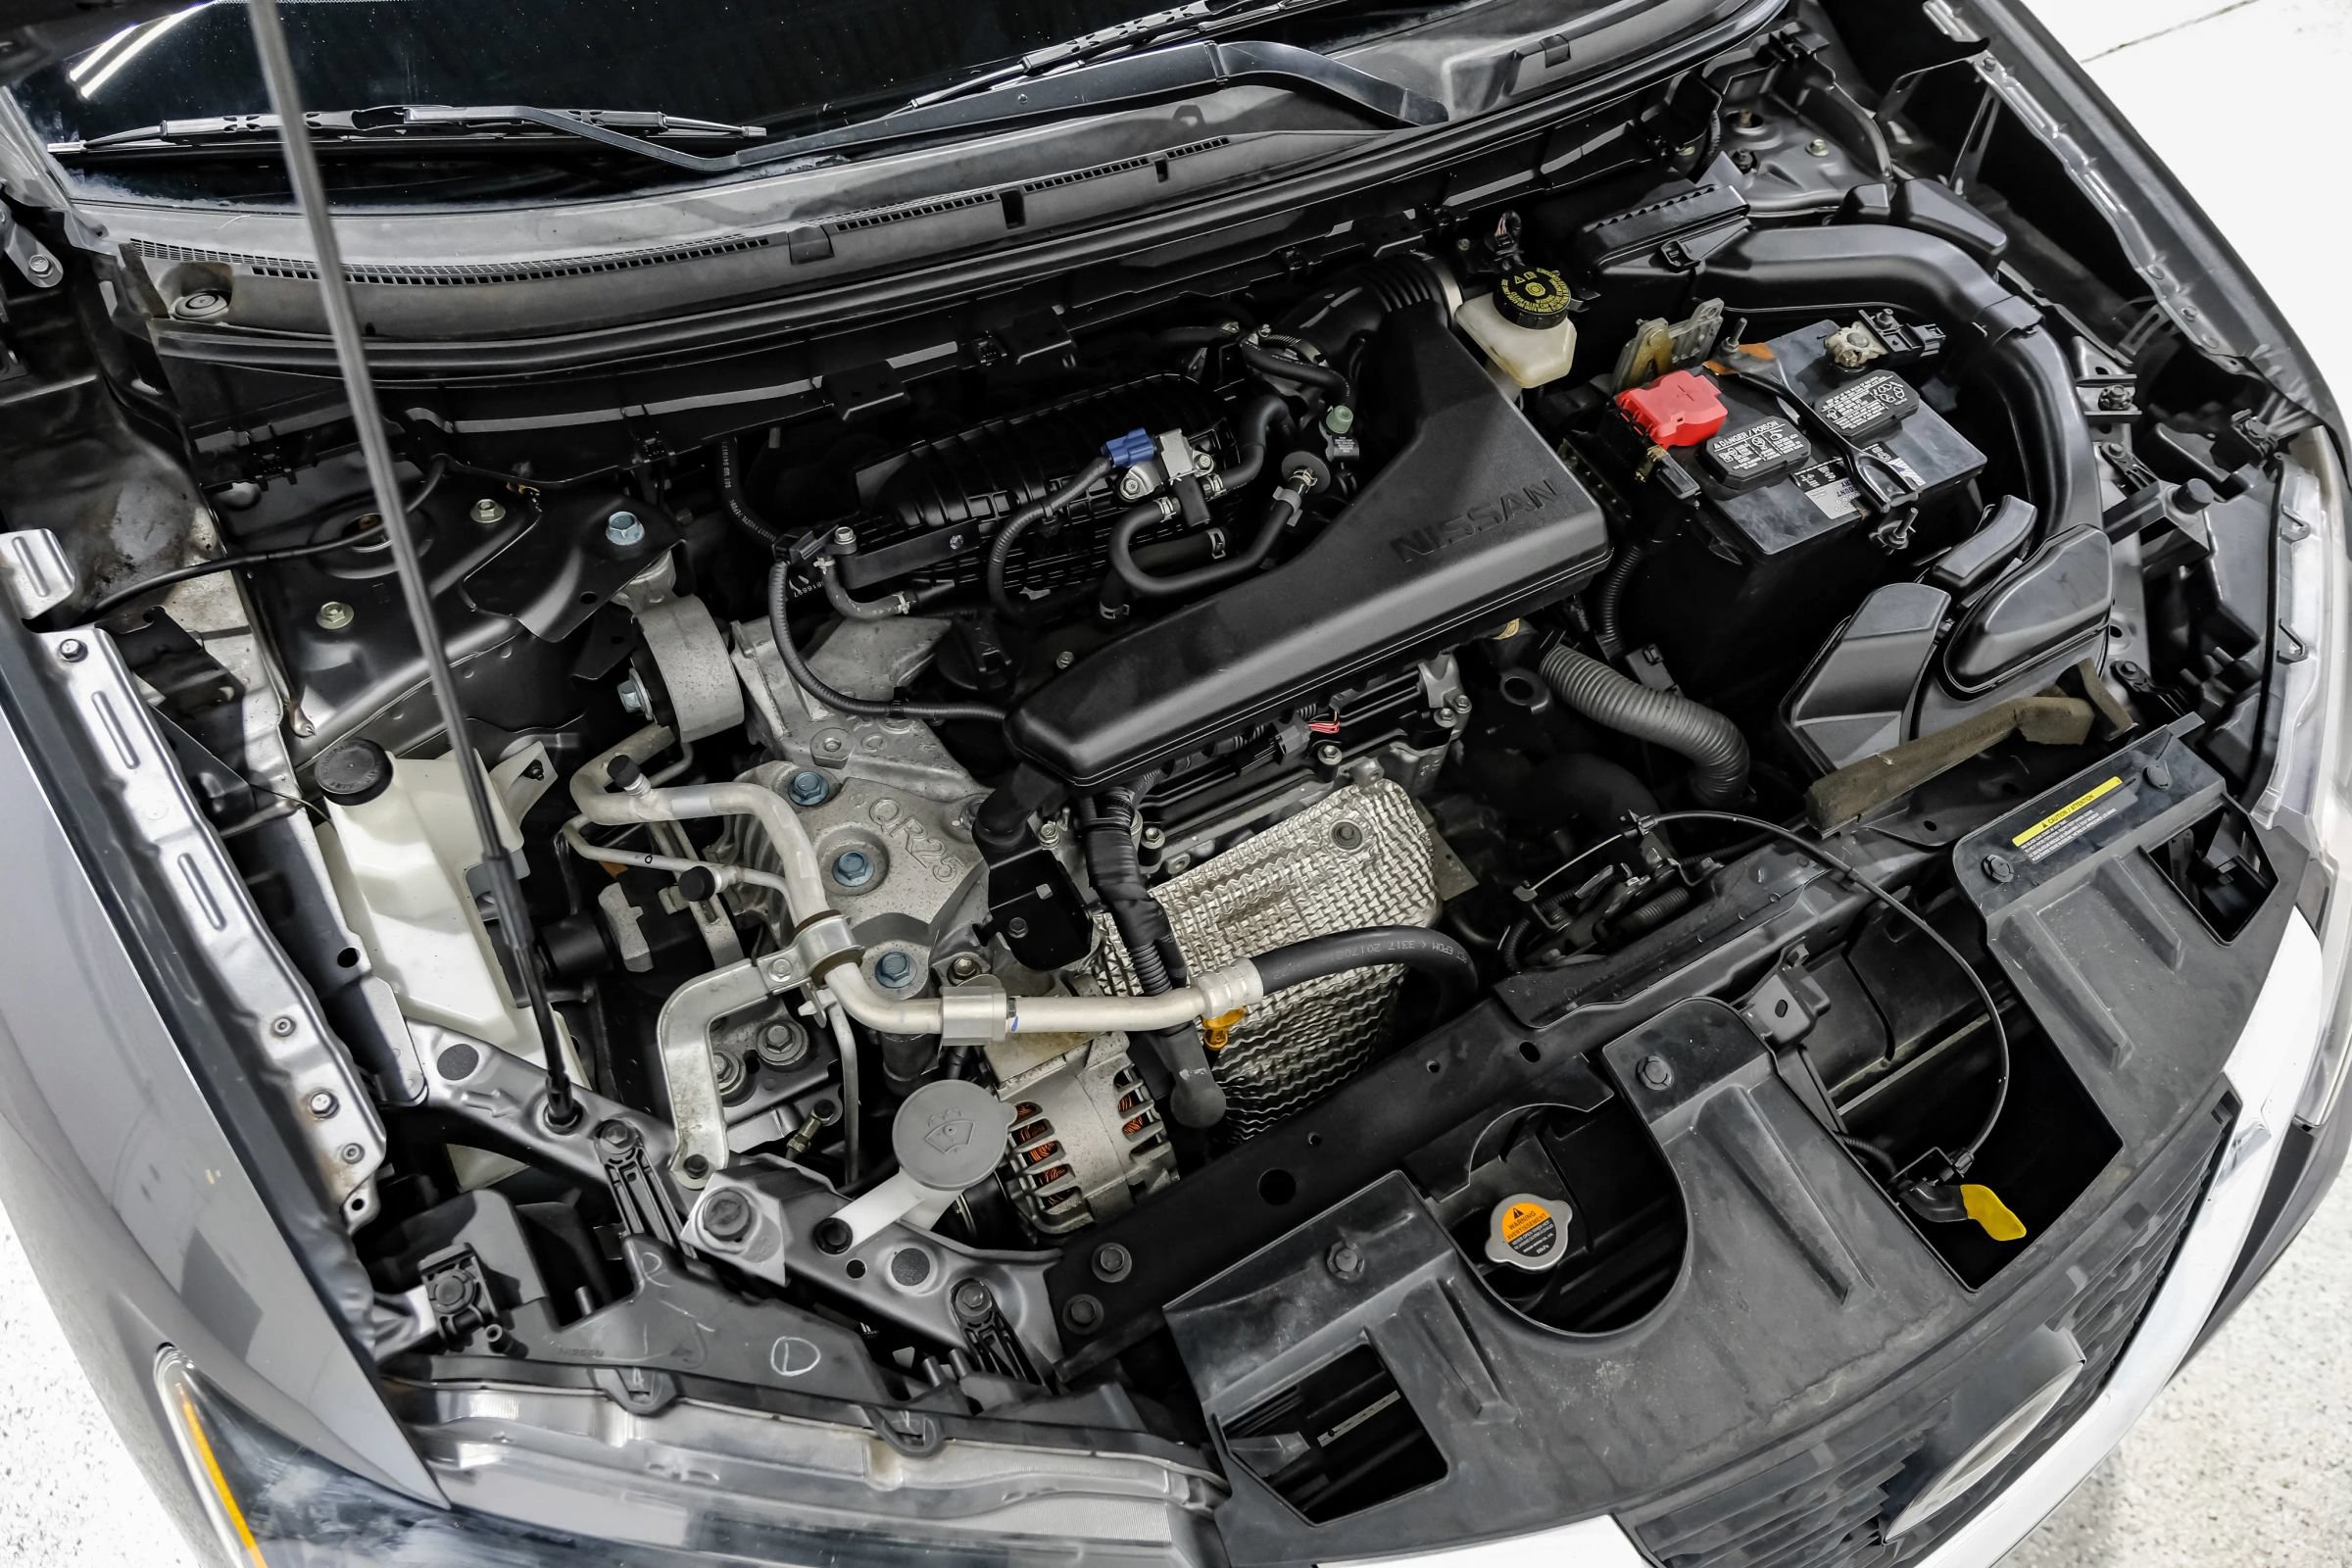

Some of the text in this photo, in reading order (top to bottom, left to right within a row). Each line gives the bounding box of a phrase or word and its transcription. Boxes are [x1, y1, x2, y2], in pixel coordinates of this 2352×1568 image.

[1719, 431, 1748, 447] DANGER
[1752, 419, 1780, 435] POISON
[1390, 478, 1558, 564] NISSAN
[2047, 809, 2068, 824] CAUTION
[2070, 794, 2094, 810] ATTENTION
[869, 797, 964, 883] QR25
[1388, 940, 1415, 951] 3317
[1432, 941, 1454, 956] EPDM
[1506, 1212, 1547, 1240] AVERTISSEMENT
[1507, 1210, 1537, 1230] WARNING
